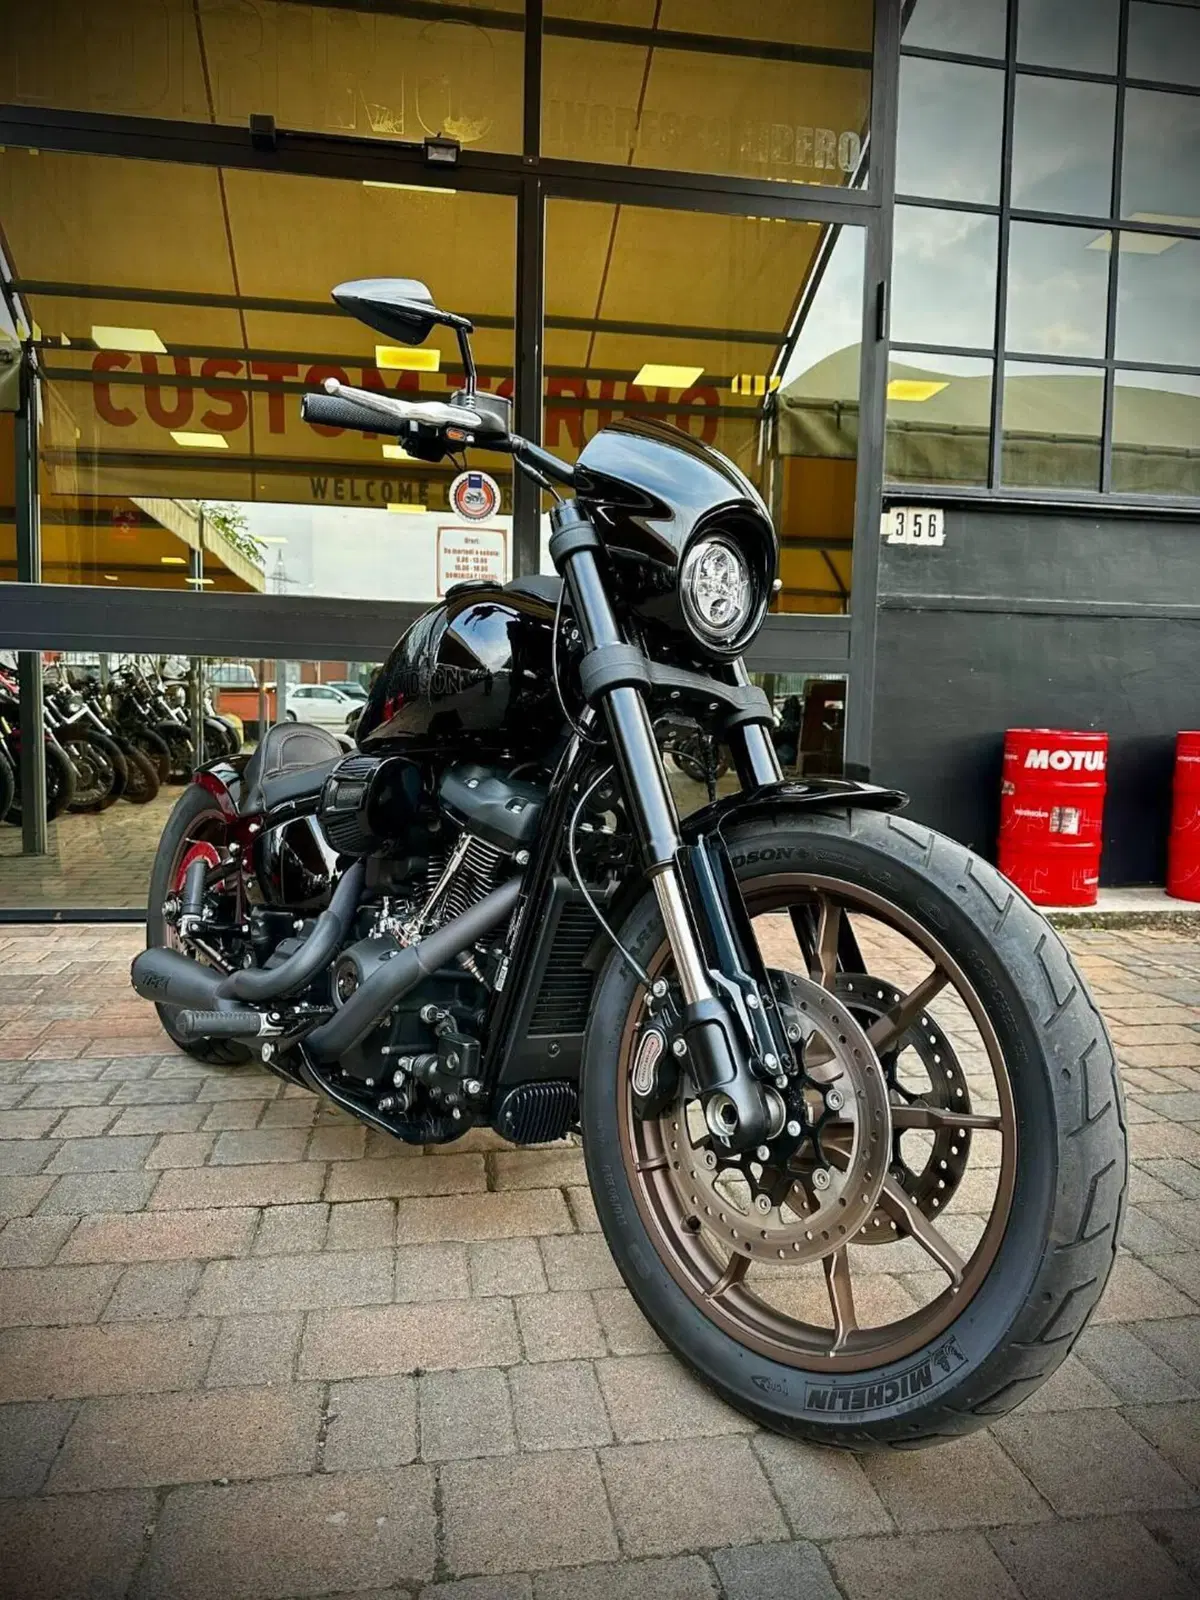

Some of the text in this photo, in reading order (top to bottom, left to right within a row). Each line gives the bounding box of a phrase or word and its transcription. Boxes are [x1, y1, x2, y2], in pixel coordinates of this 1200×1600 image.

[311, 476, 431, 507] WELCOME
[896, 512, 937, 537] 356
[1024, 748, 1105, 771] MOTUL
[807, 1362, 933, 1410] MICHELIN
